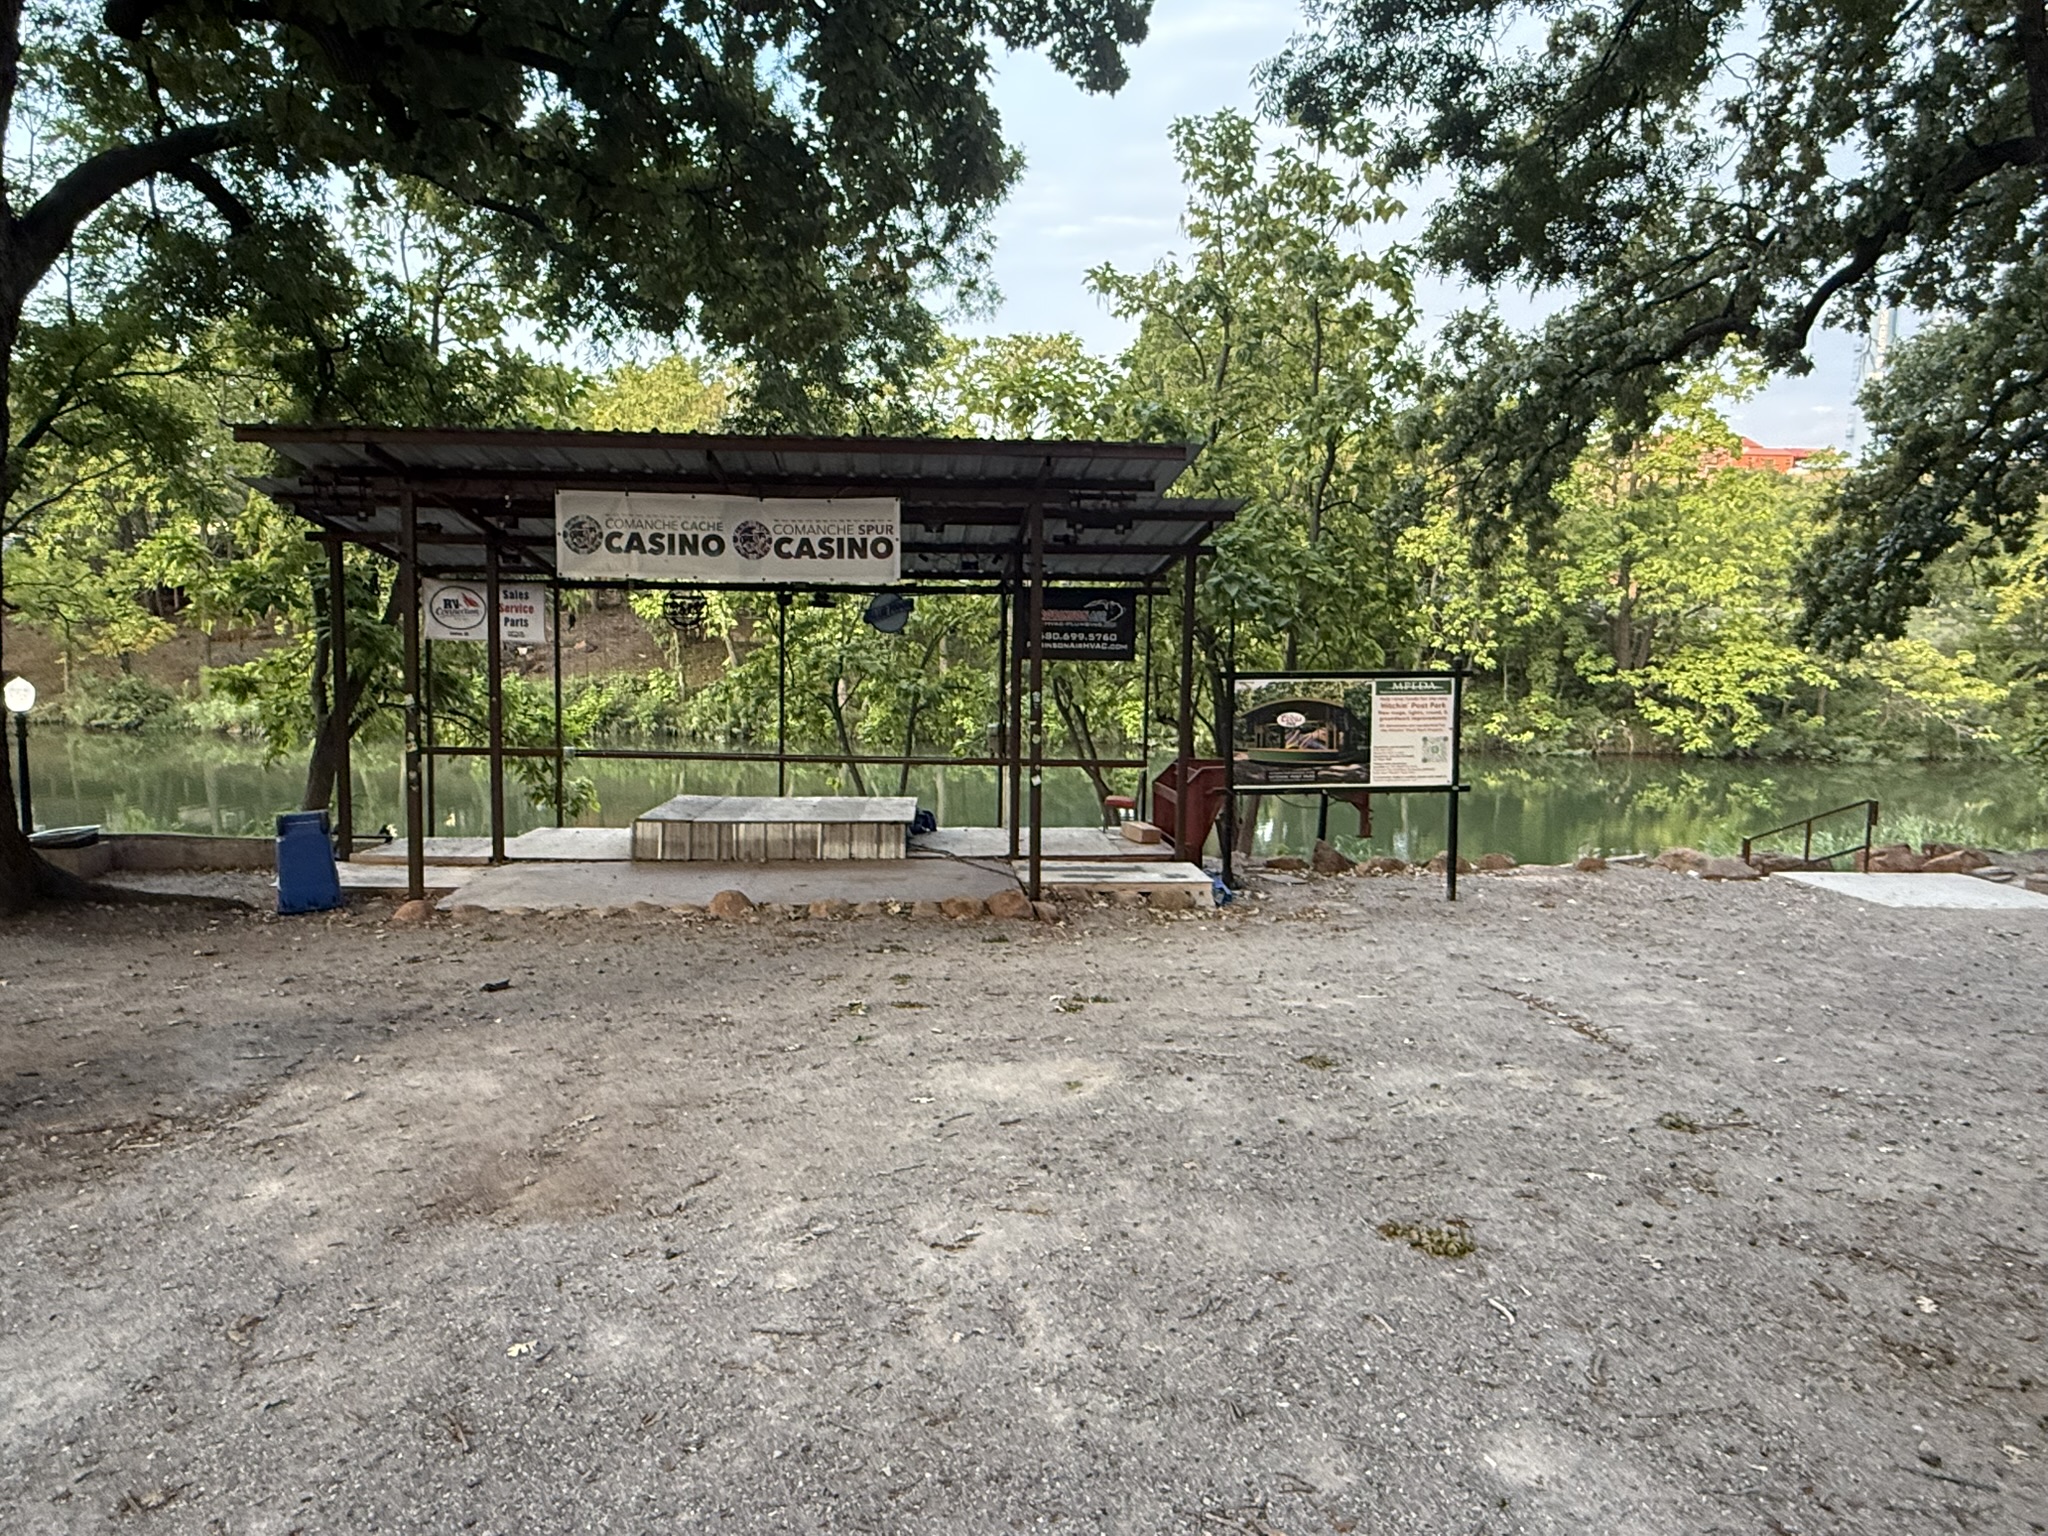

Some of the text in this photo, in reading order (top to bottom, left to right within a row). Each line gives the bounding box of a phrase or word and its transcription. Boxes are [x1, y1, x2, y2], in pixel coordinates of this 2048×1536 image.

[605, 518, 724, 532] COMANCHE CACHE
[772, 524, 894, 535] COMANCHE SPUR
[604, 531, 726, 557] CASINO
[773, 536, 894, 560] CASINO
[502, 589, 530, 601] Sales
[443, 598, 460, 609] RV
[499, 603, 534, 615] Service
[504, 617, 529, 628] Parts
